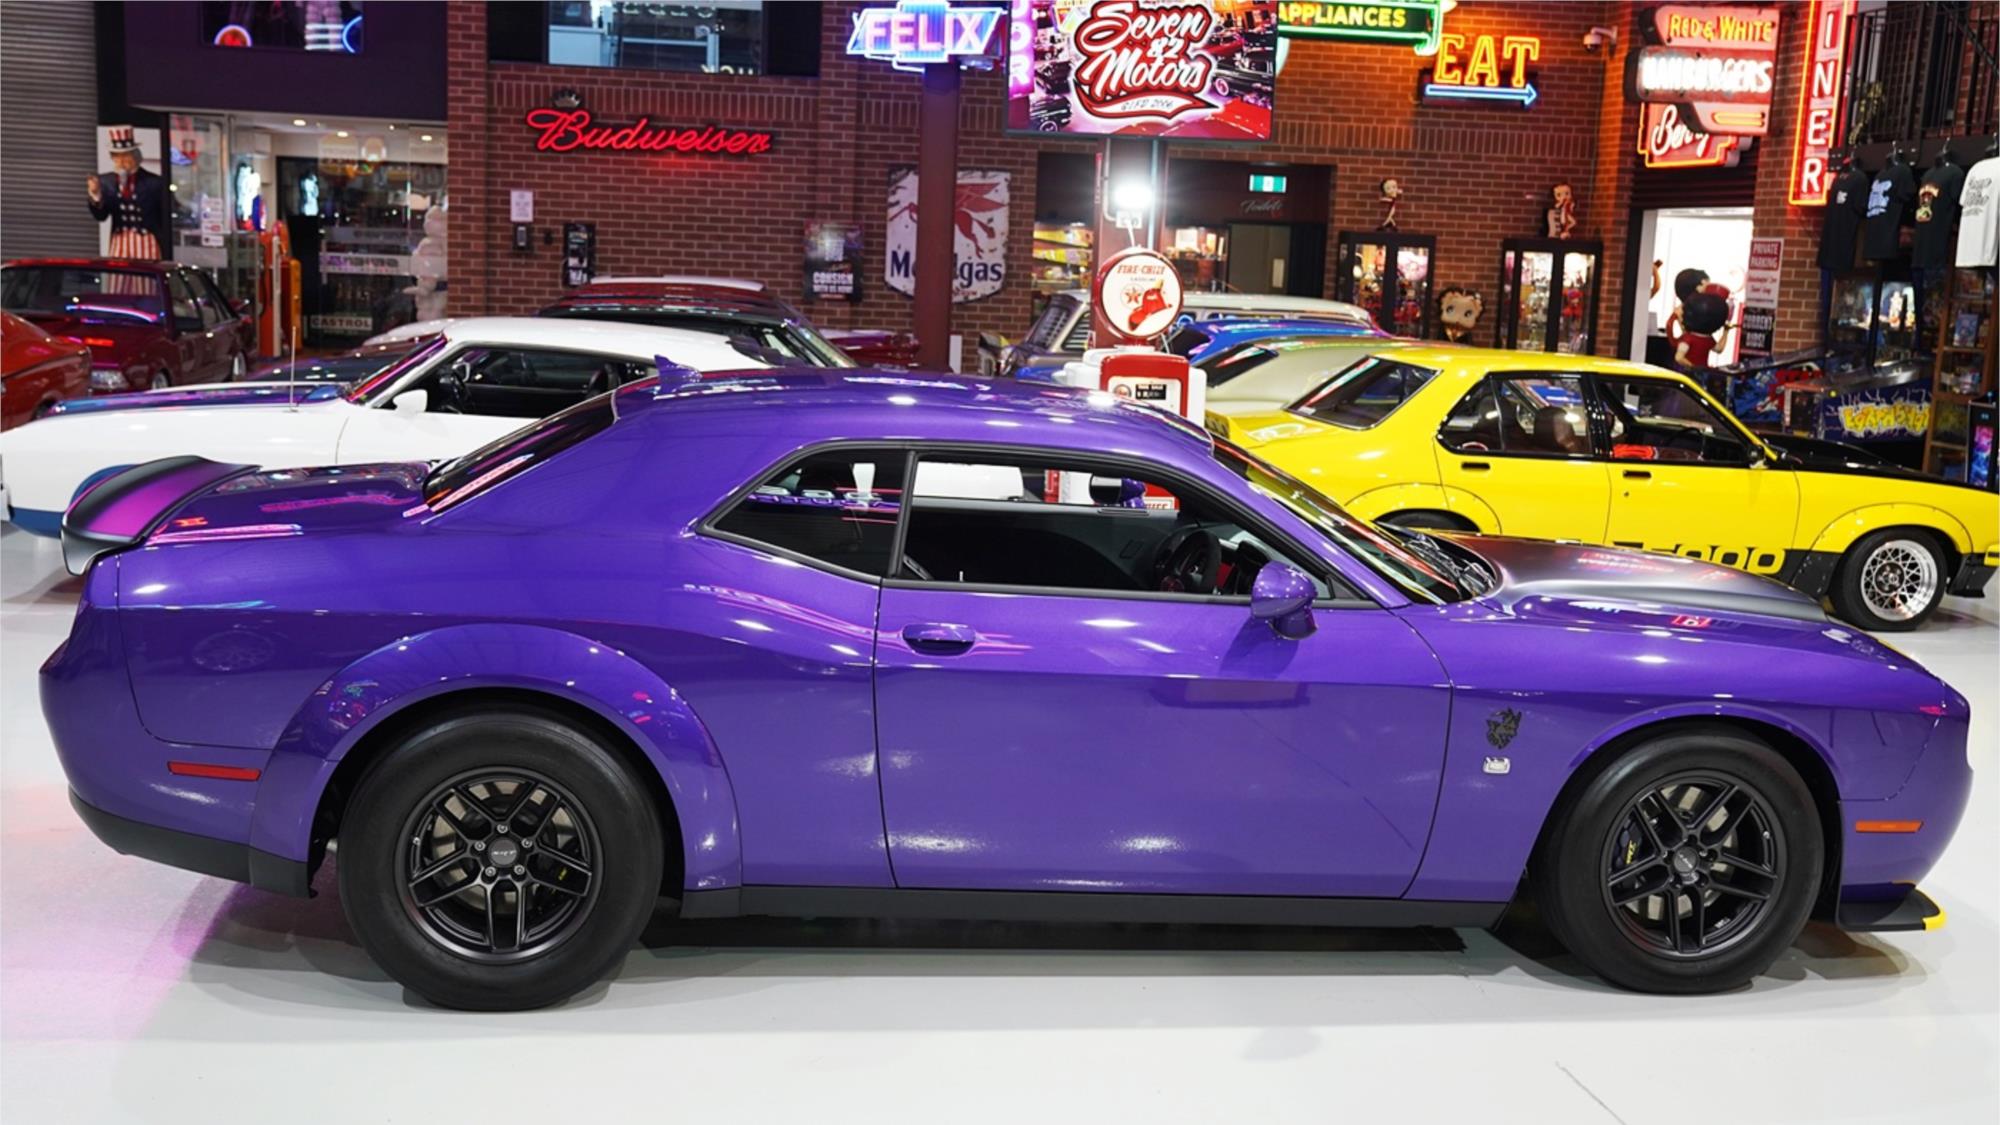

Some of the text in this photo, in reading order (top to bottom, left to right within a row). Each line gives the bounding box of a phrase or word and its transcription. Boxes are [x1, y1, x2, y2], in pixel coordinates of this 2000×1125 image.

[865, 13, 983, 51] FELIX
[1081, 1, 1206, 50] Seven
[1279, 2, 1406, 27] APPLIANCES
[1670, 14, 1772, 42] RED & WHITE
[1147, 38, 1184, 59] 82
[1434, 35, 1539, 87] EAT
[1082, 49, 1206, 98] Motors
[1642, 57, 1773, 93] HAMBURGERS
[526, 109, 771, 153] Budweiser
[1753, 242, 1778, 255] PRIVATE
[312, 318, 370, 328] CASTROL
